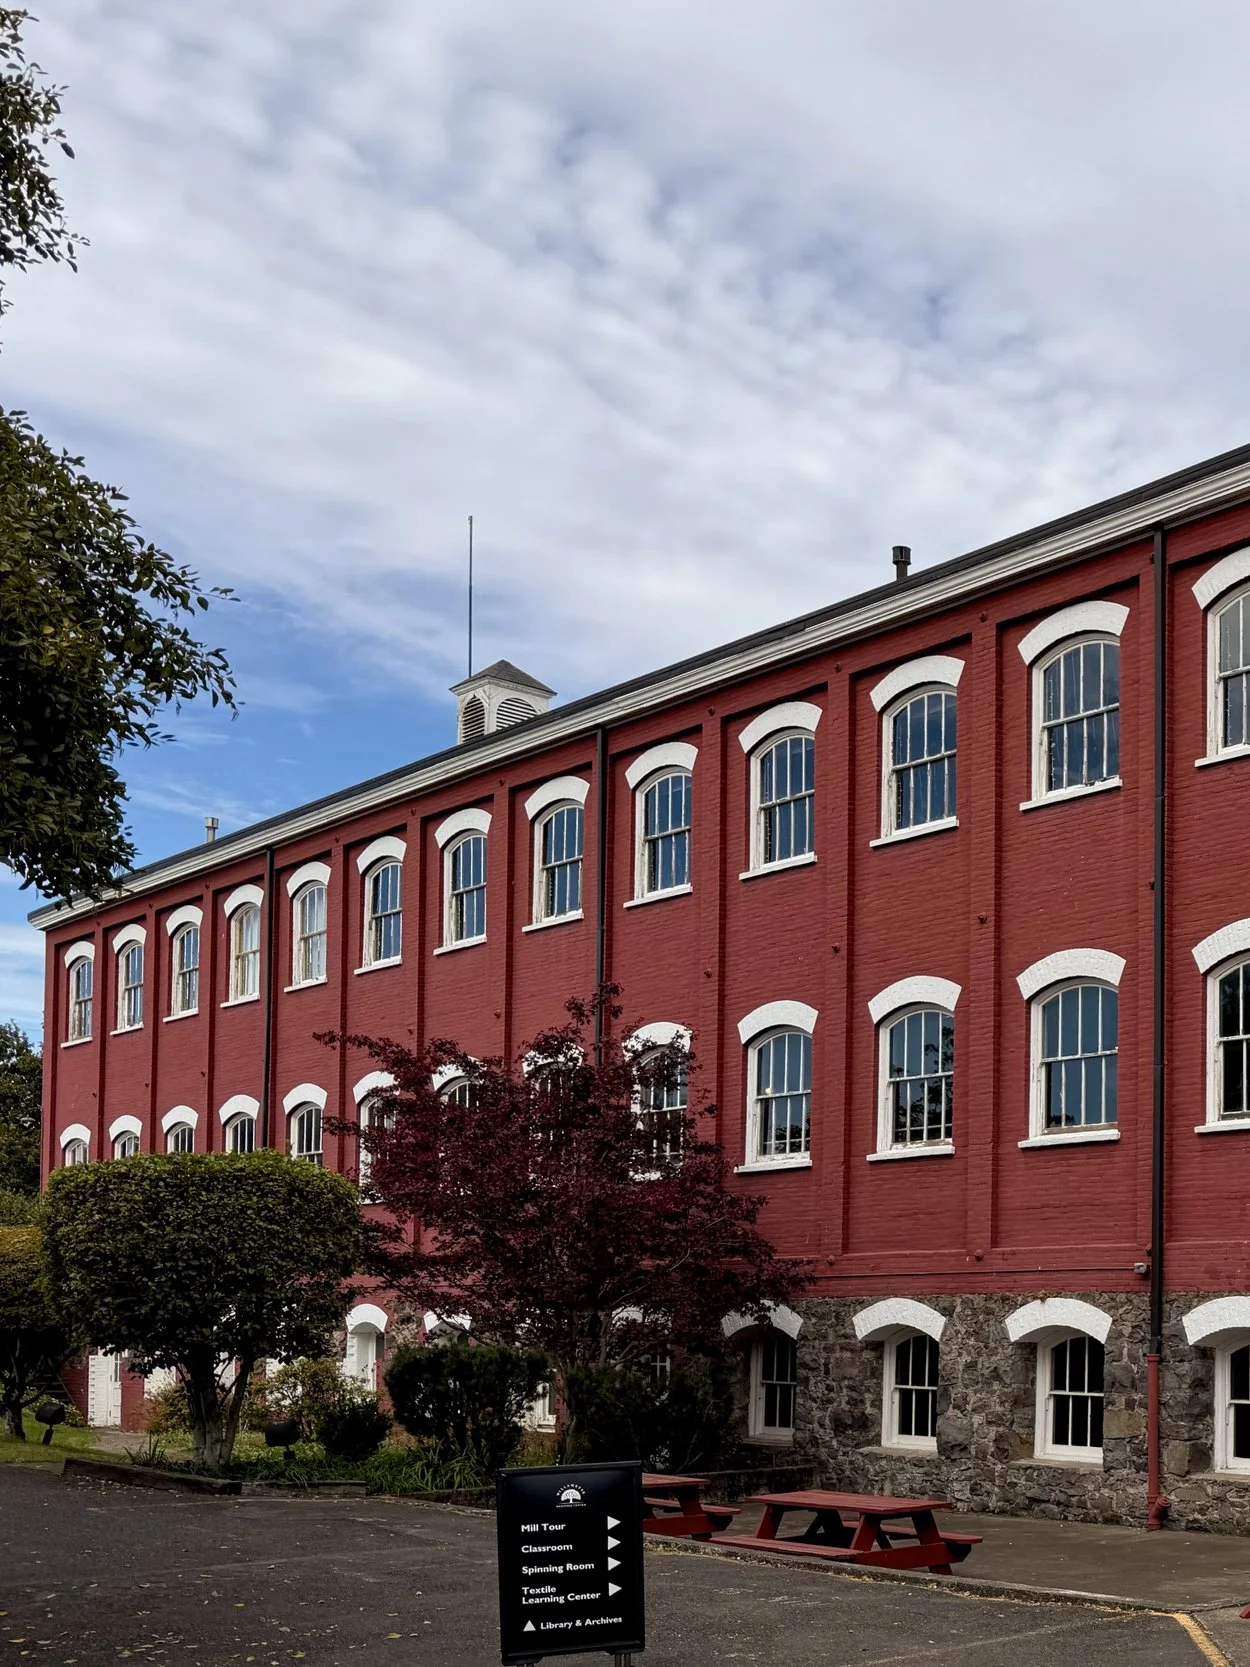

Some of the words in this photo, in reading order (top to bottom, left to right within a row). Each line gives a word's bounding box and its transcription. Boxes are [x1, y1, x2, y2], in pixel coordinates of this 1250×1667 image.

[521, 1524, 539, 1533] Mill
[541, 1523, 566, 1531] Tour
[521, 1544, 573, 1553] Classroom
[522, 1565, 564, 1576] Spinning
[566, 1563, 595, 1571] Room
[522, 1586, 556, 1595] Textile
[522, 1595, 565, 1604] Learning
[567, 1592, 601, 1601] Center
[540, 1622, 573, 1630] Library
[575, 1619, 582, 1627] &
[584, 1617, 622, 1626] Archives
